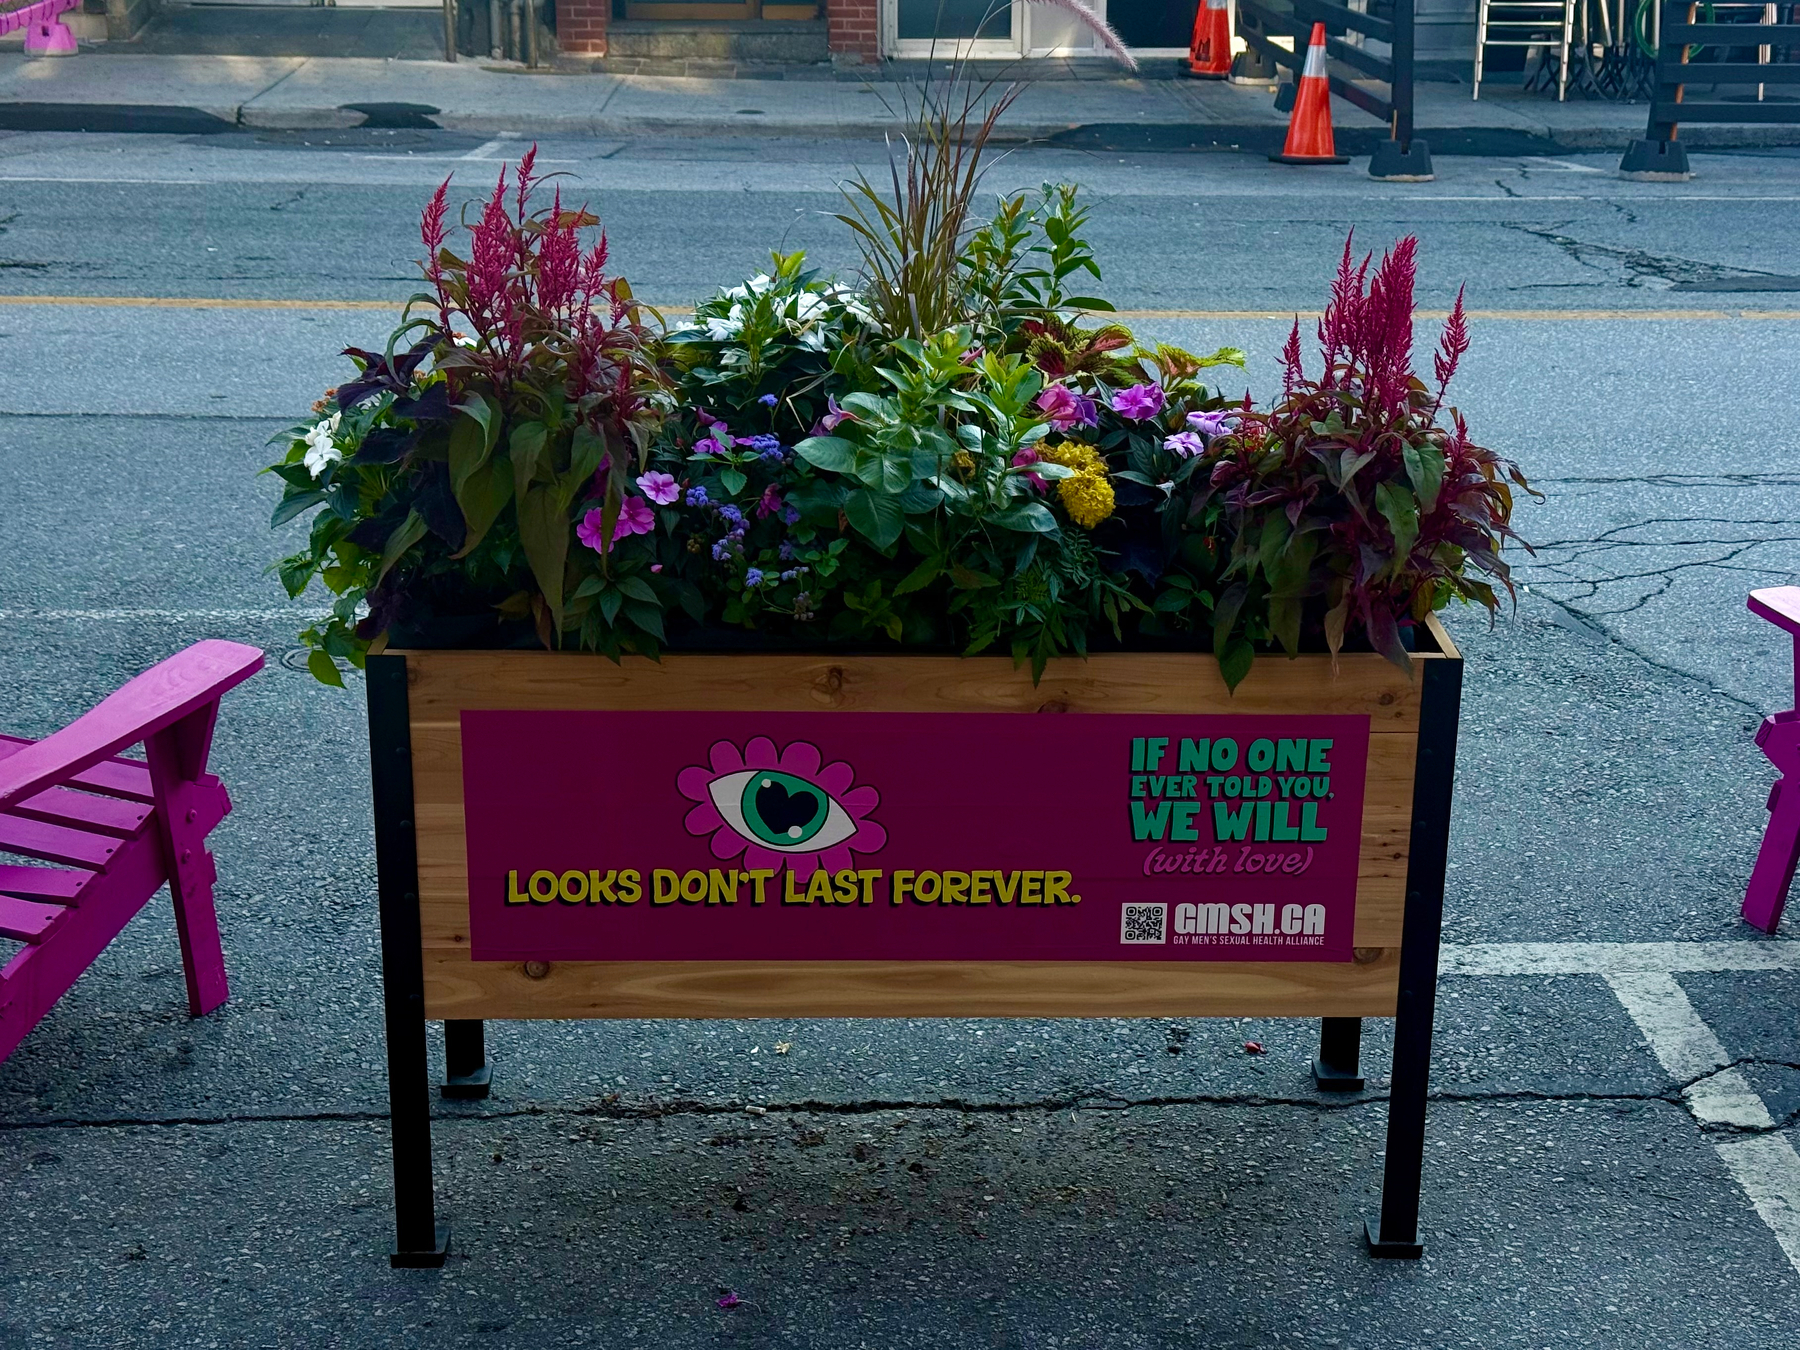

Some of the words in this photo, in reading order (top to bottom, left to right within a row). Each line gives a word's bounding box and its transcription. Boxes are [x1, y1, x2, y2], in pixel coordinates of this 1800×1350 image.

[1131, 737, 1169, 771] IF
[1179, 738, 1238, 772] NO
[1248, 738, 1333, 772] ONE
[1131, 776, 1197, 797] EVER
[1206, 776, 1272, 797] TOLD
[1278, 777, 1335, 799] YOU,
[1131, 801, 1200, 840] WE
[1214, 801, 1328, 841] WILL
[1143, 846, 1227, 875] (with
[1233, 846, 1314, 875] love)
[507, 869, 642, 903] LOOKS
[653, 869, 775, 904] DON'T
[784, 869, 883, 903] LAST
[893, 869, 1082, 904] FOREVER.
[1174, 903, 1326, 935] GMSH.CA
[1173, 935, 1189, 945] GAY
[1191, 935, 1217, 945] MEN'S
[1219, 936, 1250, 945] SEXUAL
[1252, 936, 1283, 946] HEALTH
[1285, 936, 1325, 946] ALLIANCE
